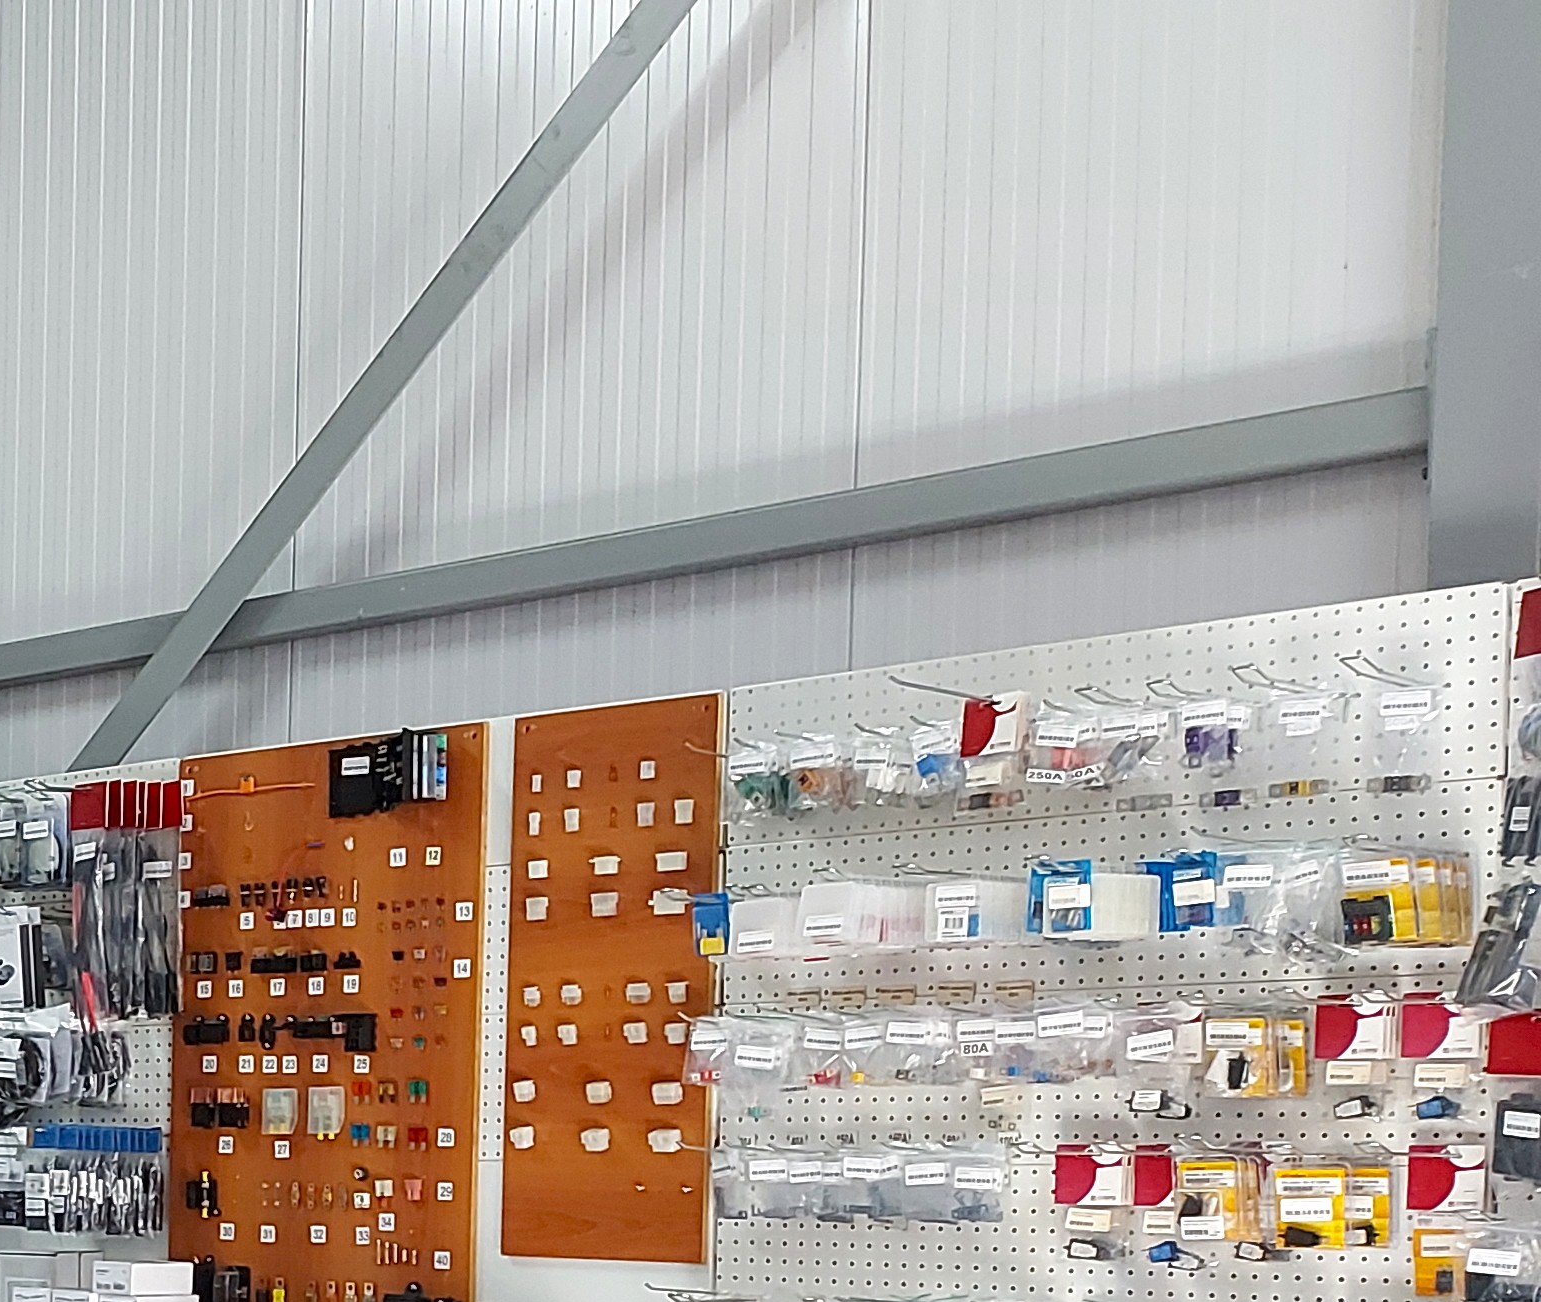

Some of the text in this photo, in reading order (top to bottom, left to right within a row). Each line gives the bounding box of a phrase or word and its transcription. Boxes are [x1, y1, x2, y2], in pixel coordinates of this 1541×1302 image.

[1028, 772, 1063, 780] 250A
[392, 851, 404, 864] 11
[428, 849, 440, 862] 12
[324, 911, 332, 923] 9
[343, 910, 356, 923] 10
[458, 905, 471, 918] 13
[242, 915, 252, 927] 5
[307, 912, 315, 924] 8
[456, 962, 468, 975] 14
[199, 984, 210, 995] 15
[230, 982, 242, 994] 16
[272, 982, 283, 993] 17
[311, 980, 322, 992] 18
[346, 978, 357, 990] 19
[963, 1043, 989, 1054] 80A
[204, 1059, 216, 1071] 20
[240, 1059, 252, 1070] 21
[264, 1059, 276, 1071] 22
[284, 1059, 296, 1071] 23
[314, 1058, 326, 1069] 24
[356, 1059, 368, 1070] 25
[440, 1132, 452, 1143] 28
[276, 1143, 288, 1155] 27
[440, 1186, 453, 1198] 29
[380, 1216, 392, 1228] 34
[222, 1226, 233, 1237] 30
[262, 1229, 274, 1240] 31
[312, 1229, 324, 1241] 32
[358, 1230, 370, 1242] 33
[436, 1255, 449, 1266] 40
